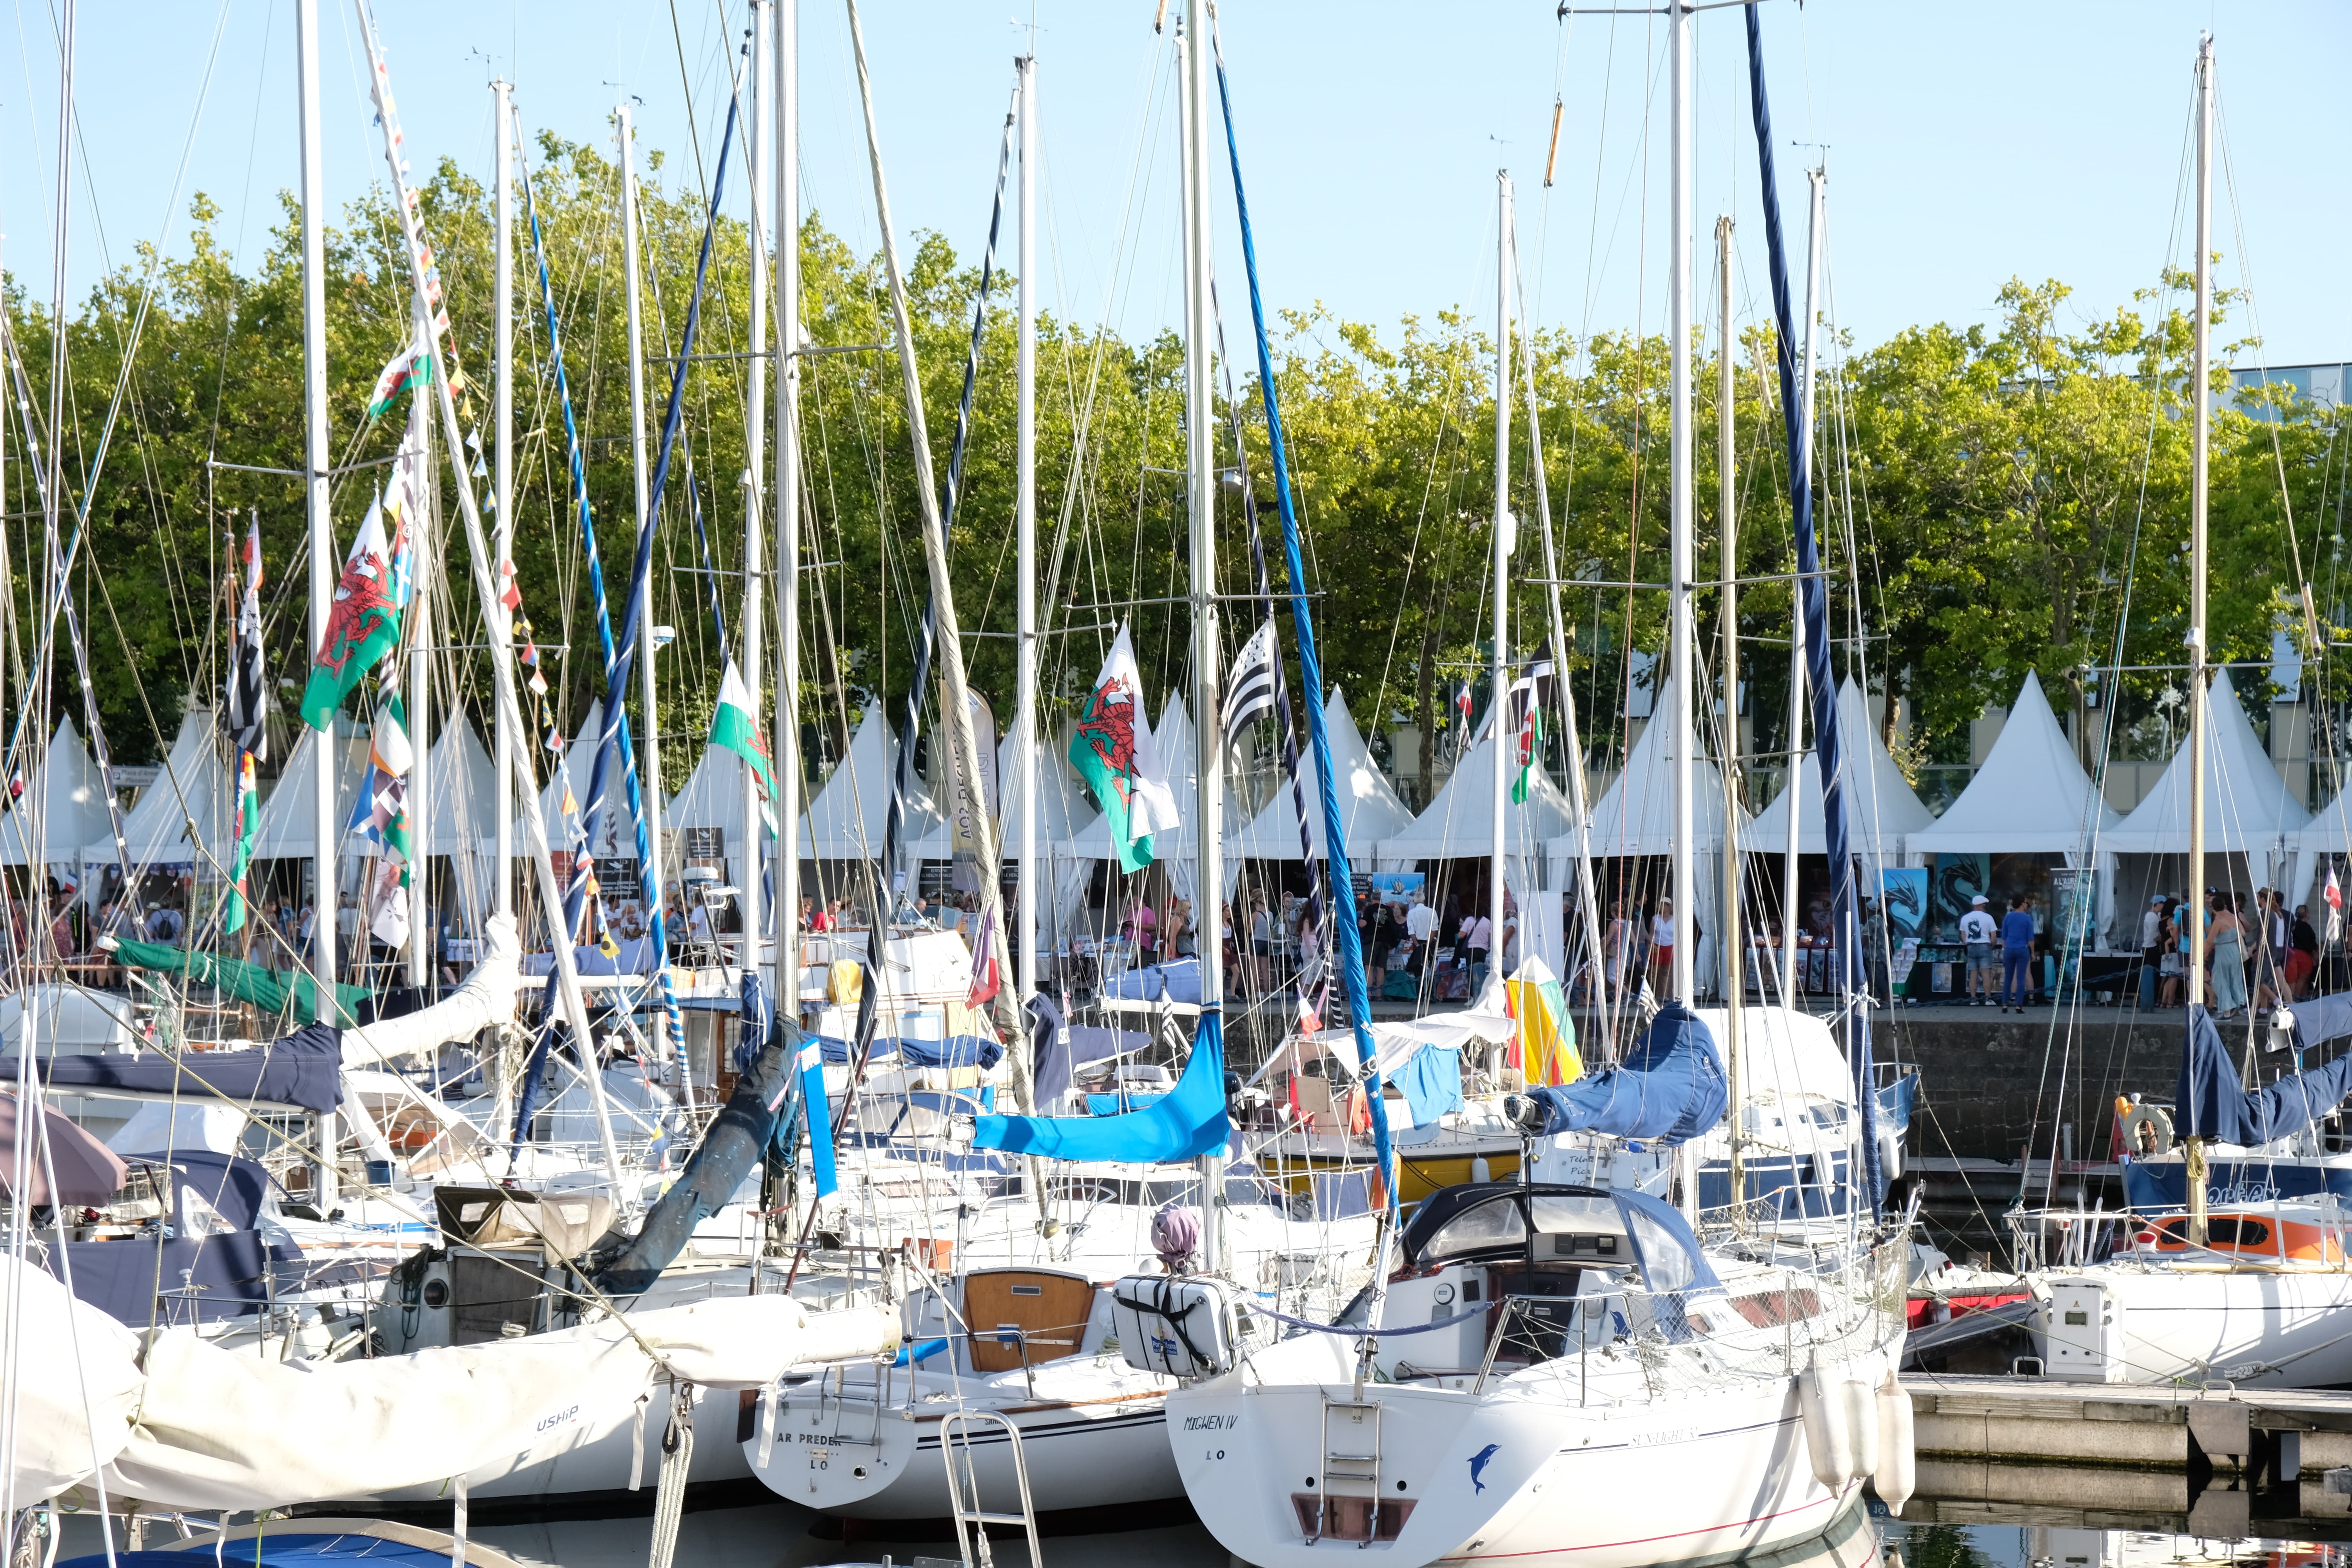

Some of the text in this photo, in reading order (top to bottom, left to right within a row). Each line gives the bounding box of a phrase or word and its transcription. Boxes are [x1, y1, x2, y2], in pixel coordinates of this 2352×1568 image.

[1184, 1415, 1238, 1430] MIGWEN IV
[777, 1433, 791, 1443] AR
